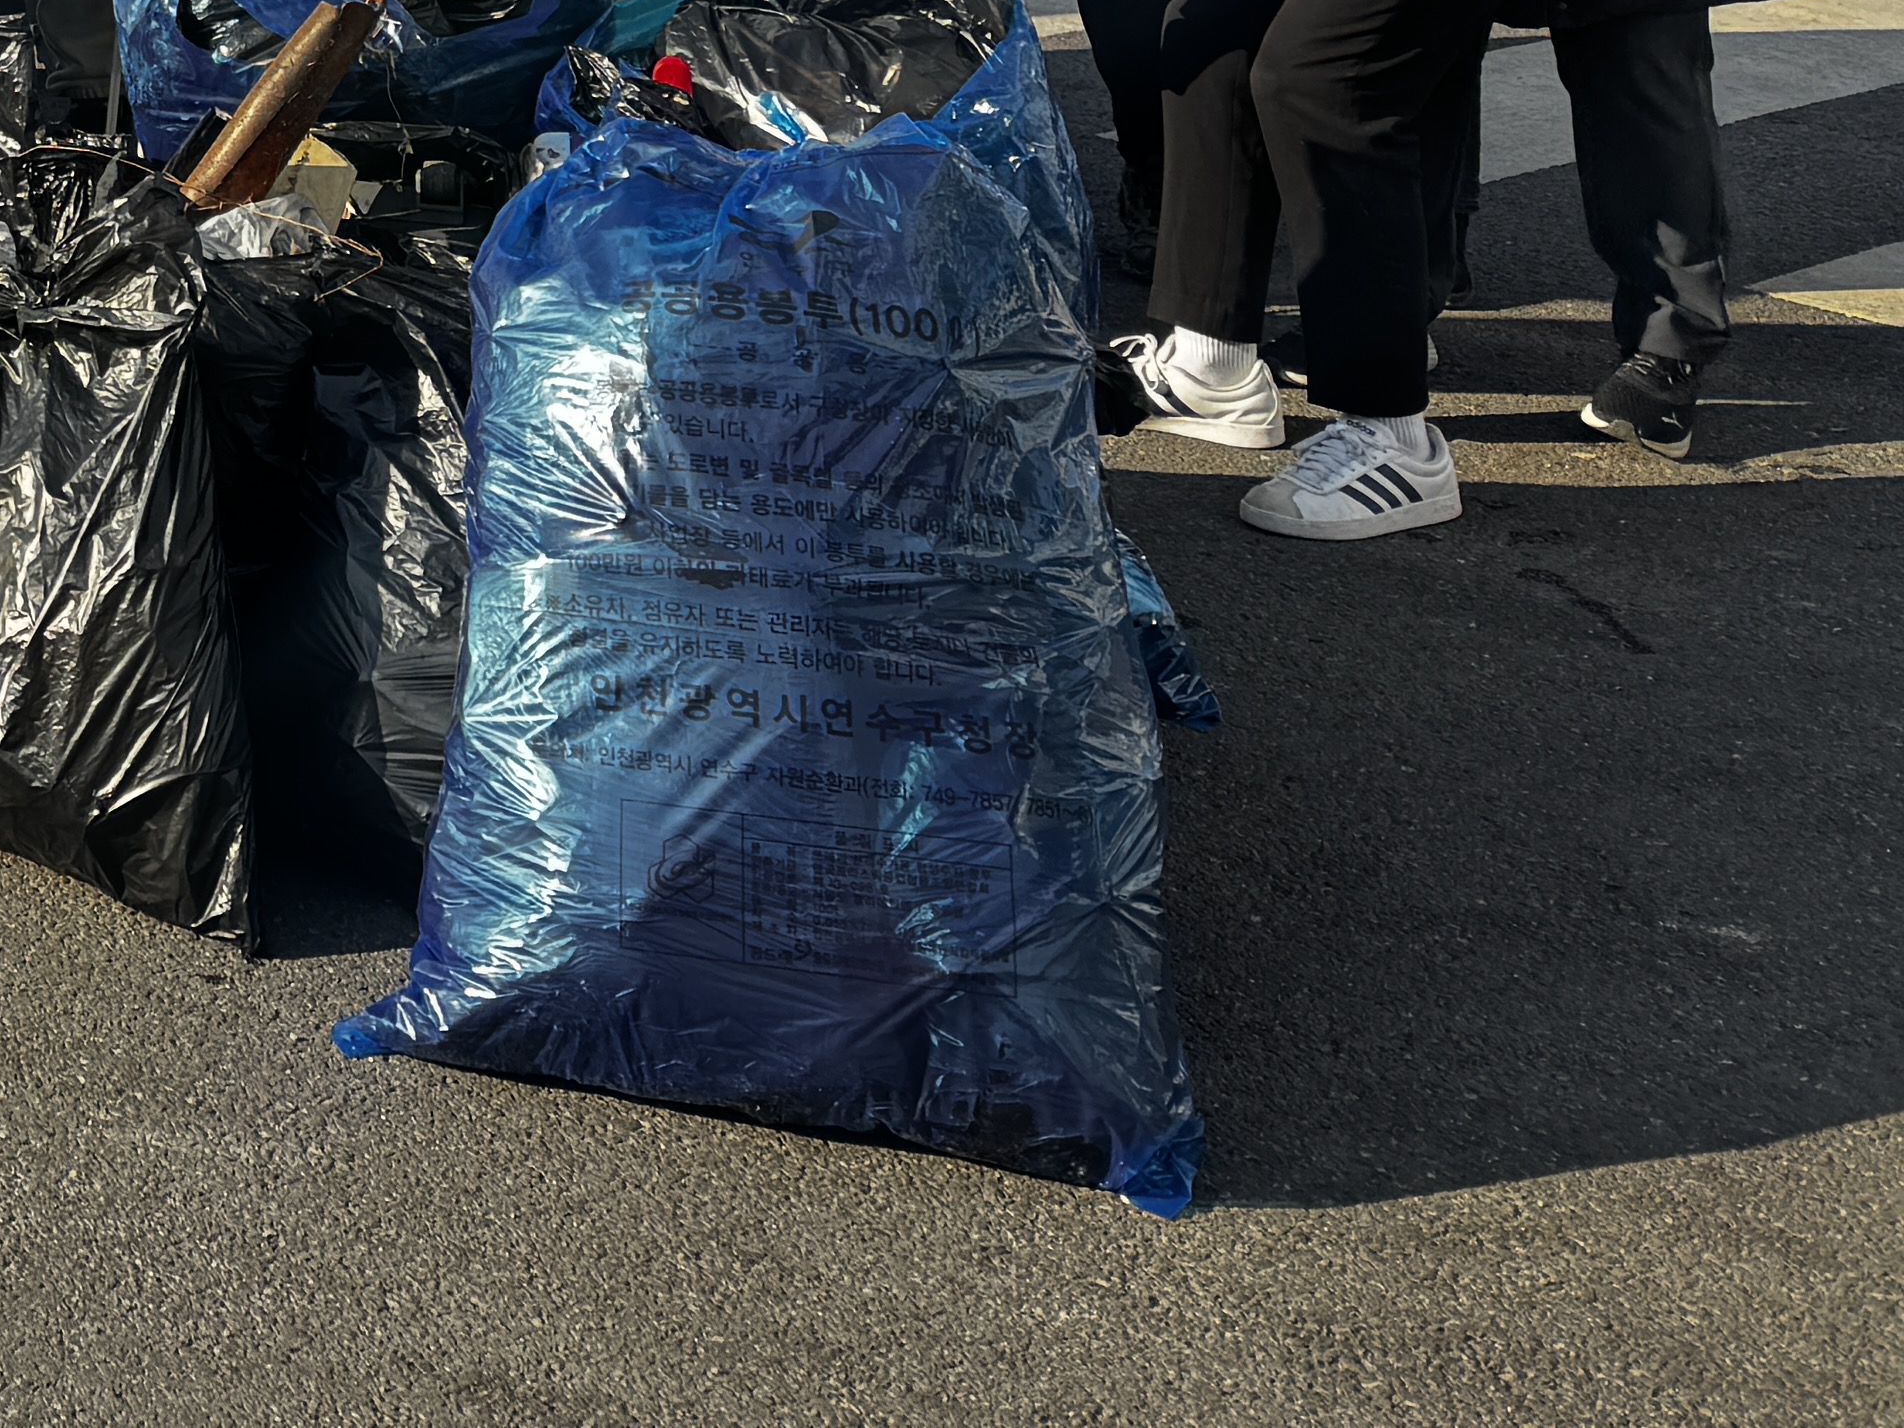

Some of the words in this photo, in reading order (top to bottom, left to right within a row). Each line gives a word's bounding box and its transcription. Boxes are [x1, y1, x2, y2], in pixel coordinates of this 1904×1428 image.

[664, 413, 755, 445] 있습니다.
[666, 451, 729, 477] 도로변
[751, 492, 837, 523] 용도에만
[721, 528, 785, 555] 등에서
[796, 536, 816, 559] 이
[824, 541, 888, 569] 봉투를
[643, 600, 704, 628] 점유자
[716, 606, 758, 632] 또는
[768, 611, 854, 641] 관리자는
[639, 631, 747, 665] 유지하도록
[756, 640, 864, 678] 노력하여야
[598, 745, 692, 776] 인천광역시
[700, 756, 759, 784] 연수구
